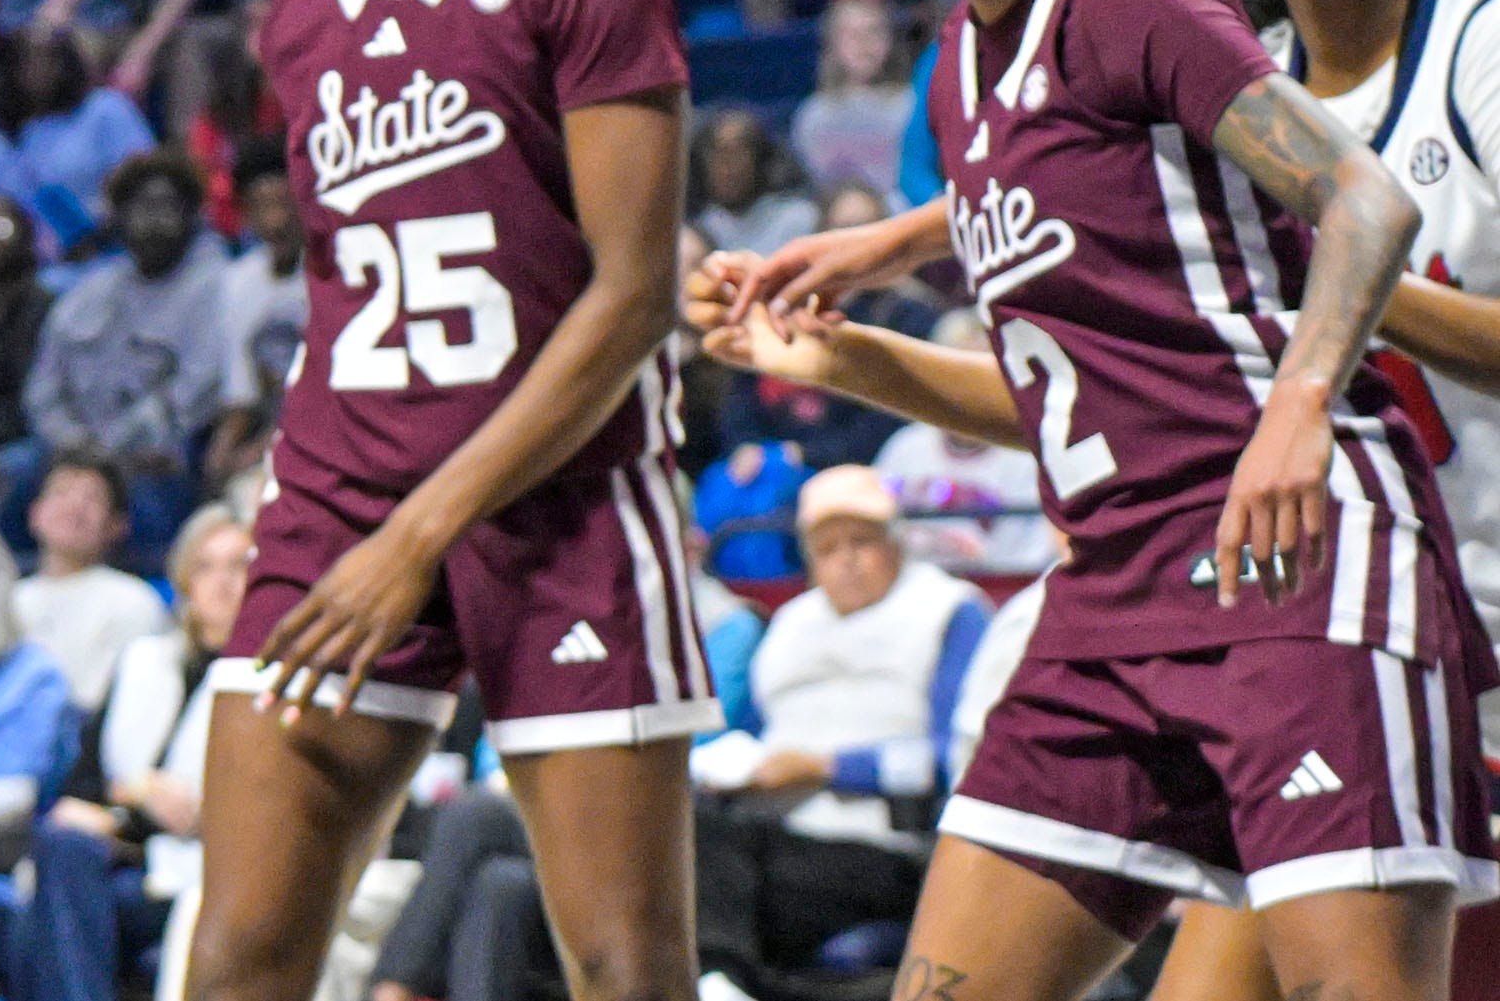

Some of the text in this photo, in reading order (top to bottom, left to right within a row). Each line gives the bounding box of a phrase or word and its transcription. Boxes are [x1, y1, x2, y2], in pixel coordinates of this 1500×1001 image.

[308, 69, 503, 204] State
[330, 211, 518, 391] 25
[1001, 317, 1118, 501] 2
